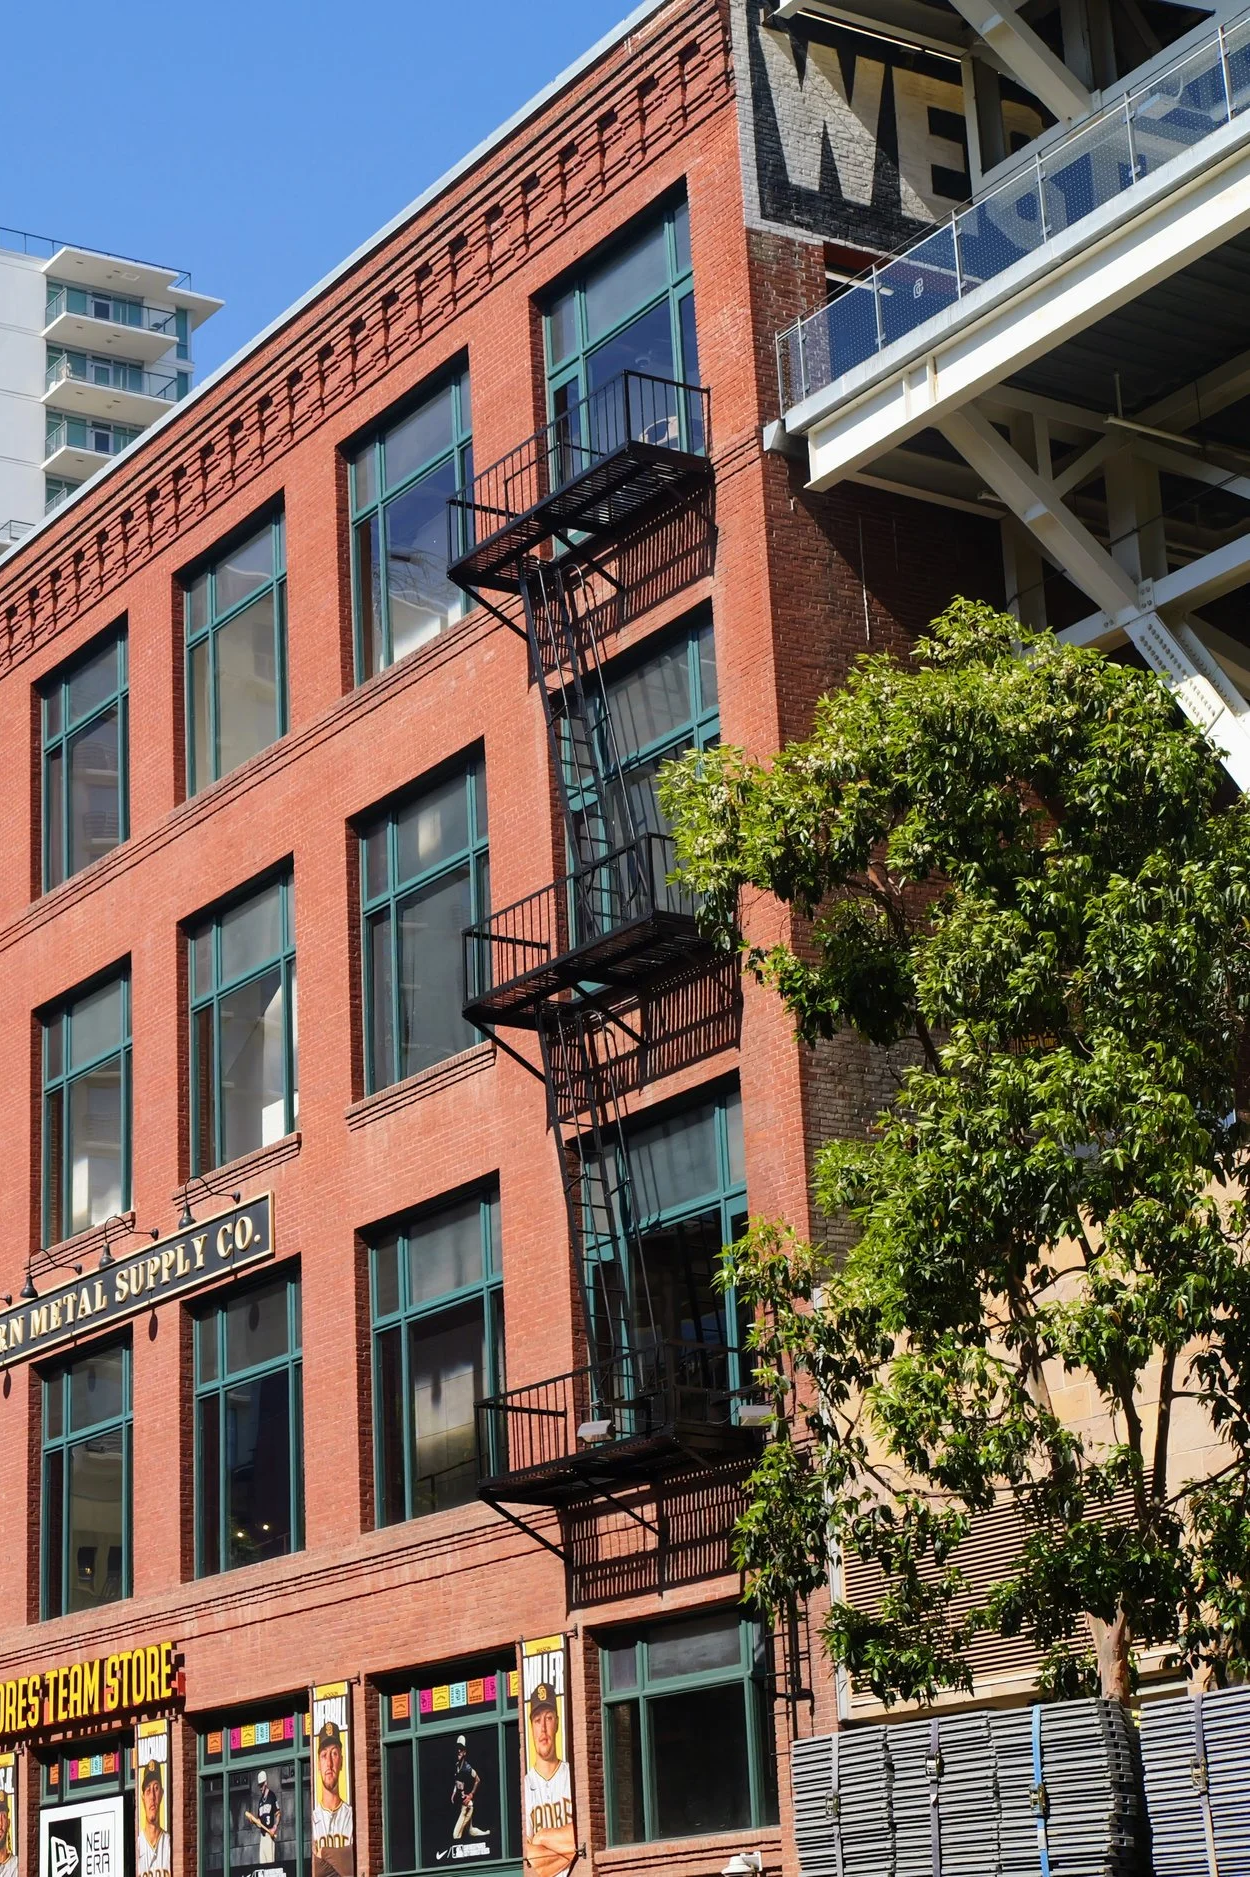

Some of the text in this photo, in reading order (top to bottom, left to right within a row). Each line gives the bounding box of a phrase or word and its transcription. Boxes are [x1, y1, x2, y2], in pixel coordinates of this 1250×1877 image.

[30, 1280, 108, 1338] METAL
[115, 1233, 208, 1303] SUPPLY
[216, 1215, 261, 1259] CO.
[45, 1658, 101, 1723] TEAM
[106, 1641, 172, 1710] STORE
[86, 1829, 110, 1853] NEW
[86, 1852, 110, 1876] ERA
